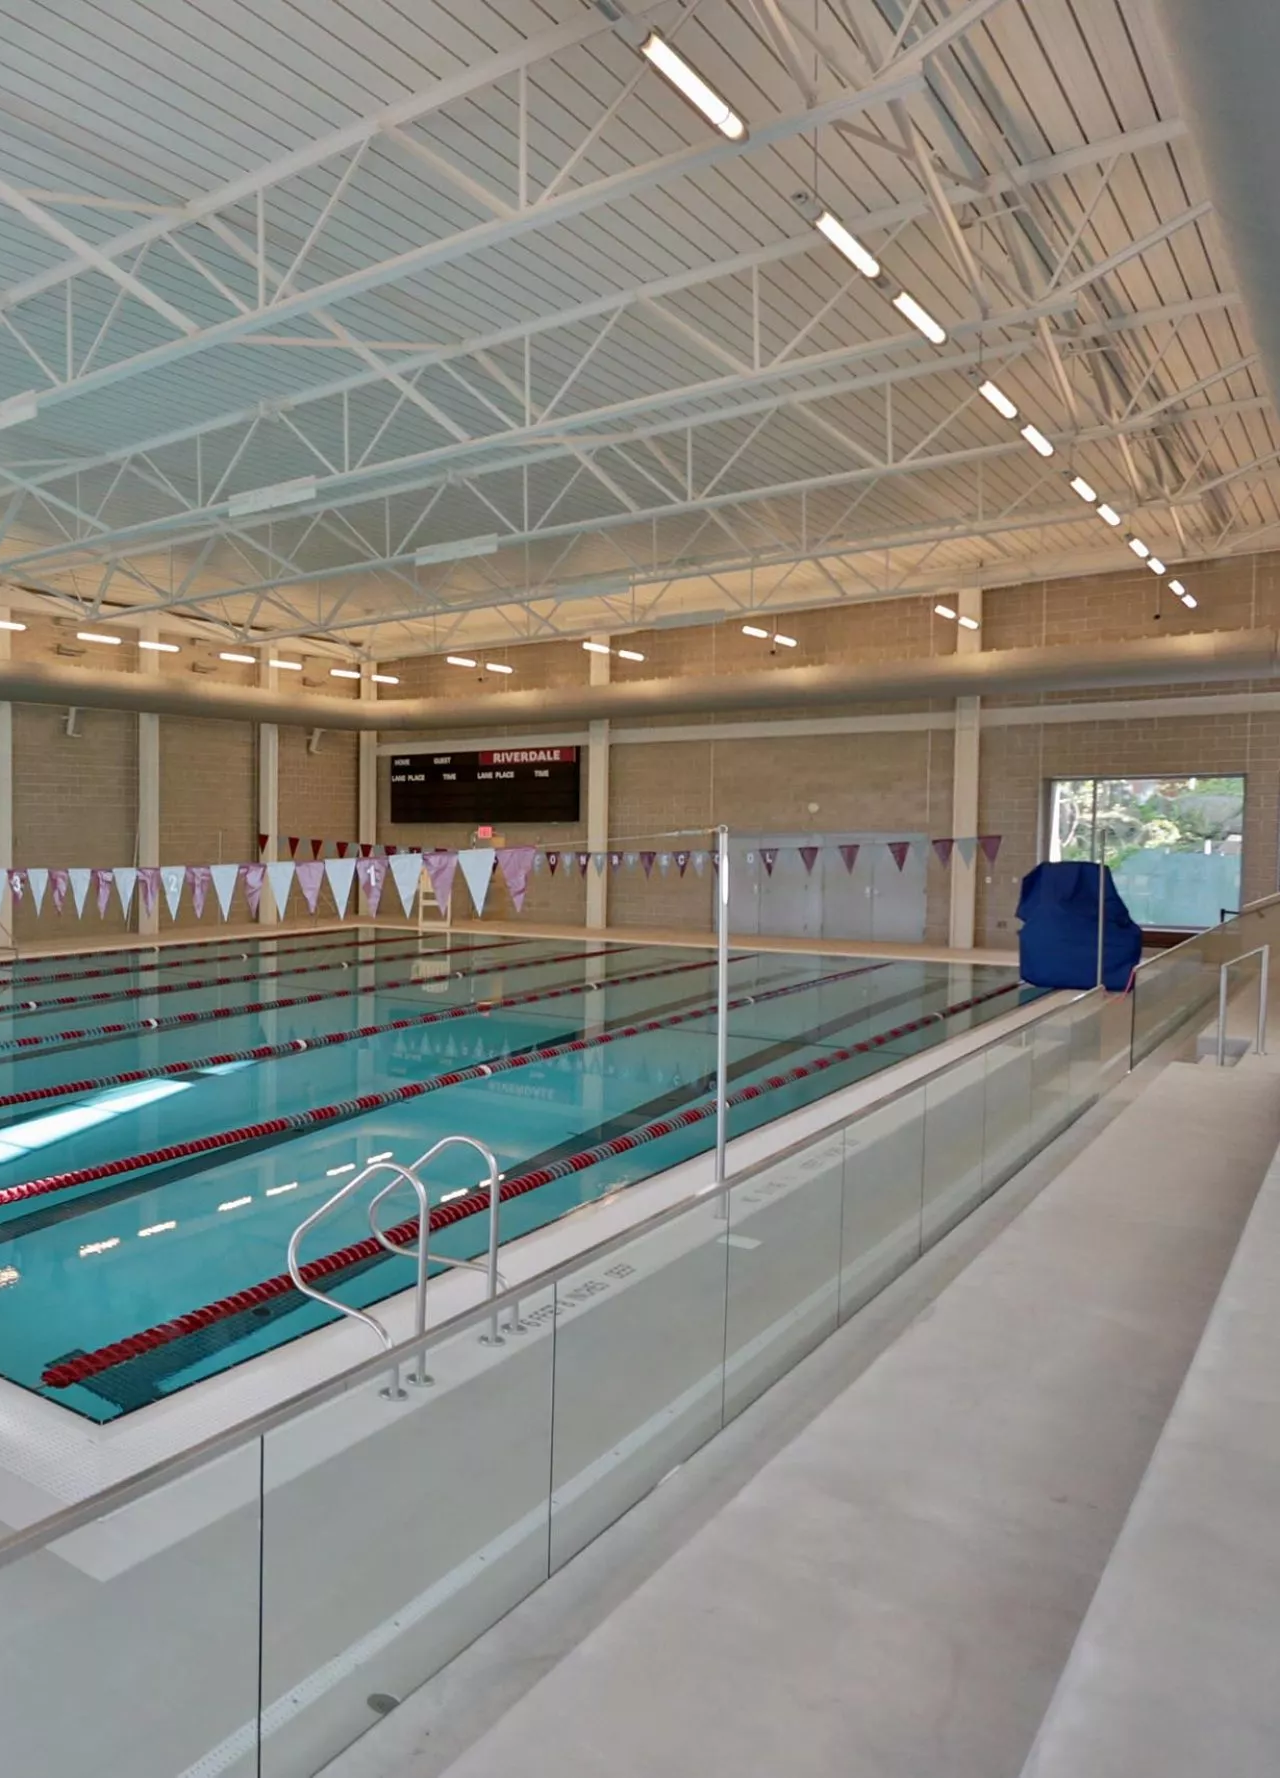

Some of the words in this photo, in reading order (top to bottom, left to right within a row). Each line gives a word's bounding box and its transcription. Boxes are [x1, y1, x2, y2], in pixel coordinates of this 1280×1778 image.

[493, 750, 561, 764] RIVERDALE
[495, 771, 515, 779] PLACE
[169, 874, 178, 891] 2
